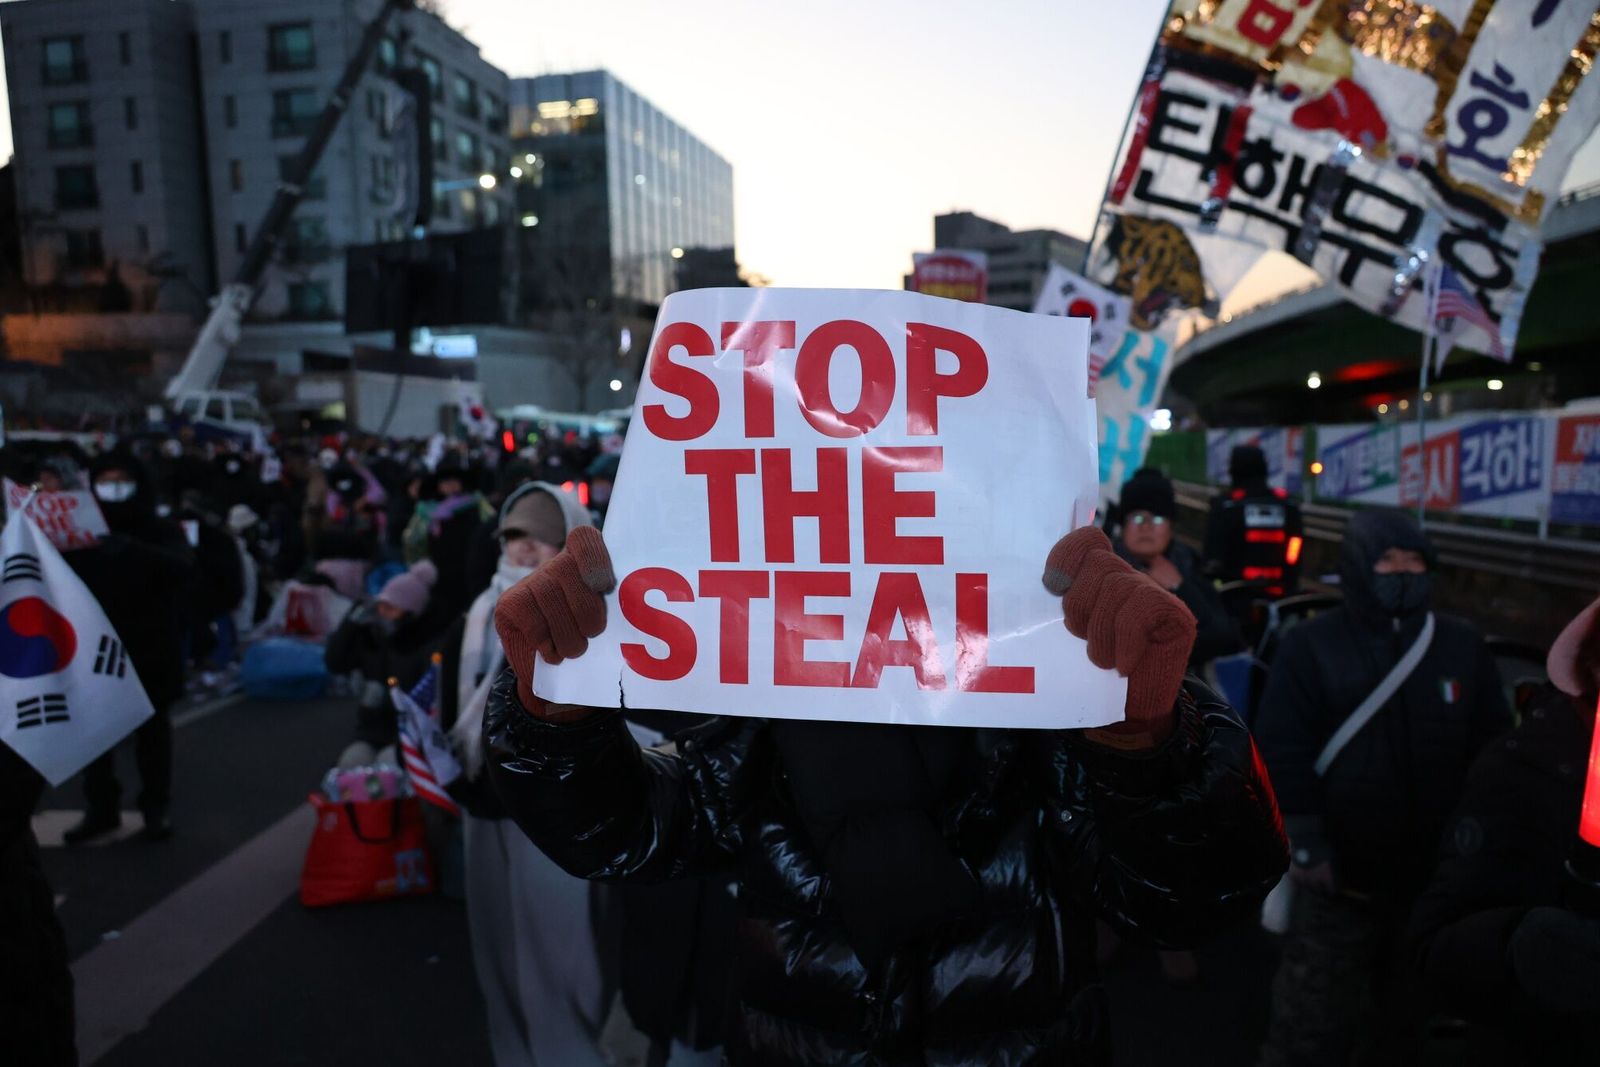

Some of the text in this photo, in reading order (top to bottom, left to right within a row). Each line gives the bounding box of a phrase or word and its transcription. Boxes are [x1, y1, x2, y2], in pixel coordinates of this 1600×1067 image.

[642, 319, 989, 441] STOP
[684, 446, 944, 565] THE
[1461, 420, 1541, 493] 각하!
[618, 567, 1036, 694] STEAL
